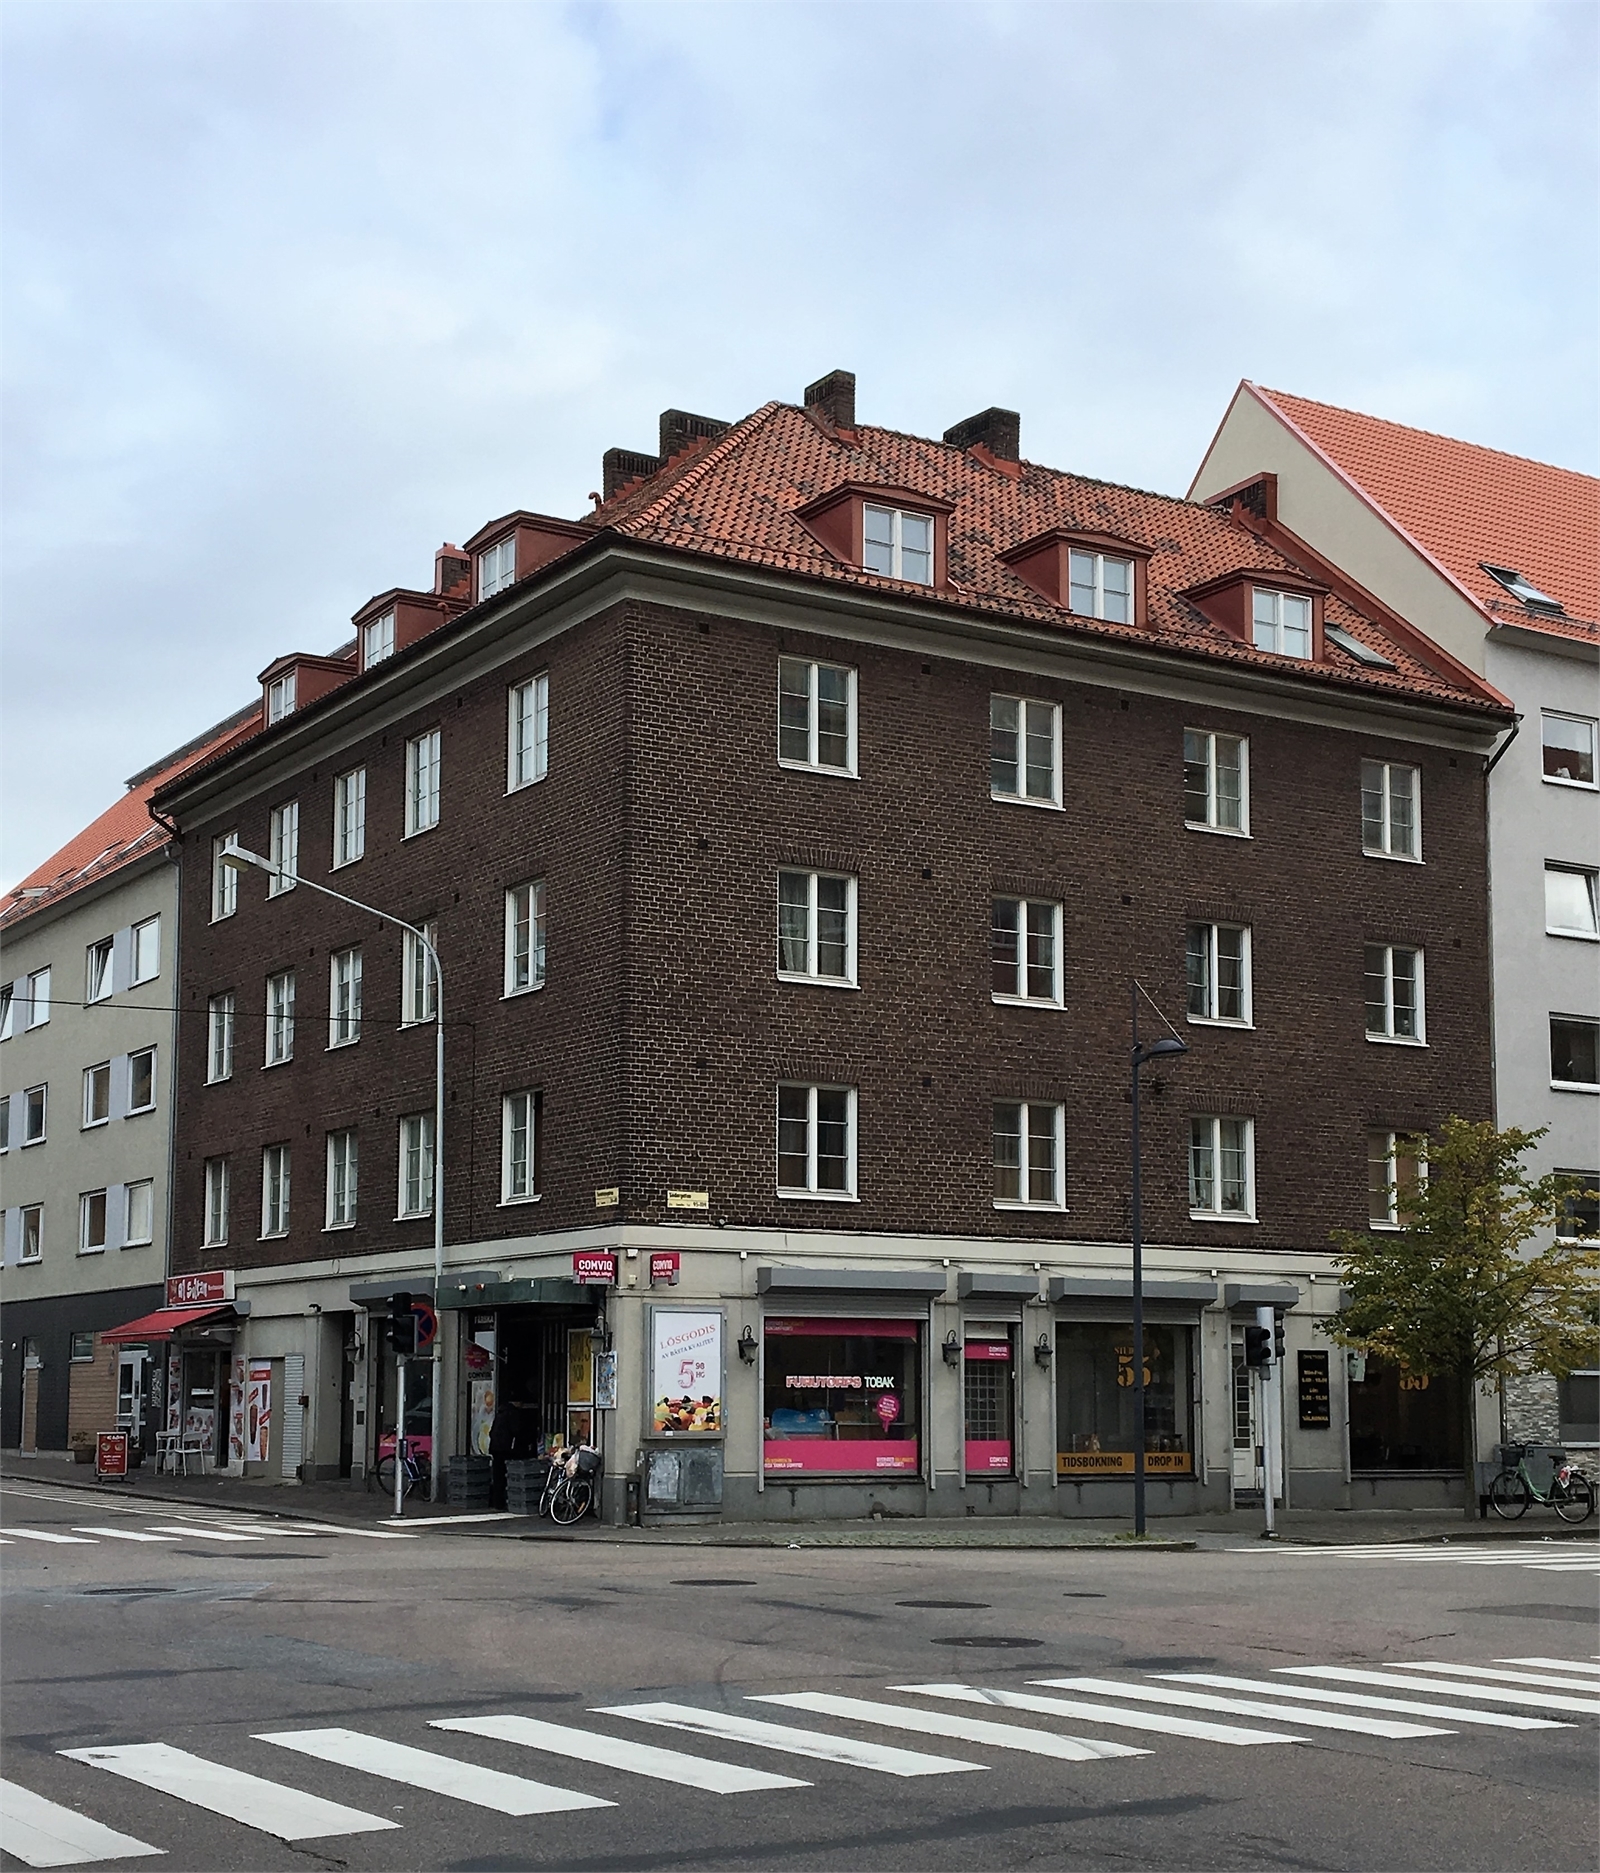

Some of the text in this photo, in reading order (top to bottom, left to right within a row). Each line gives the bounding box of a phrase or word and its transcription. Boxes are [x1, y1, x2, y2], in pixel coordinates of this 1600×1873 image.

[578, 1260, 613, 1271] COMVIQ
[652, 1260, 673, 1271] COMVIQ
[660, 1324, 716, 1349] LÖSGODIS
[678, 1359, 695, 1389] 5
[786, 1375, 895, 1388] FURUTORPS TOBAK
[1062, 1456, 1185, 1468] TIDSBOKNING DROP IN
